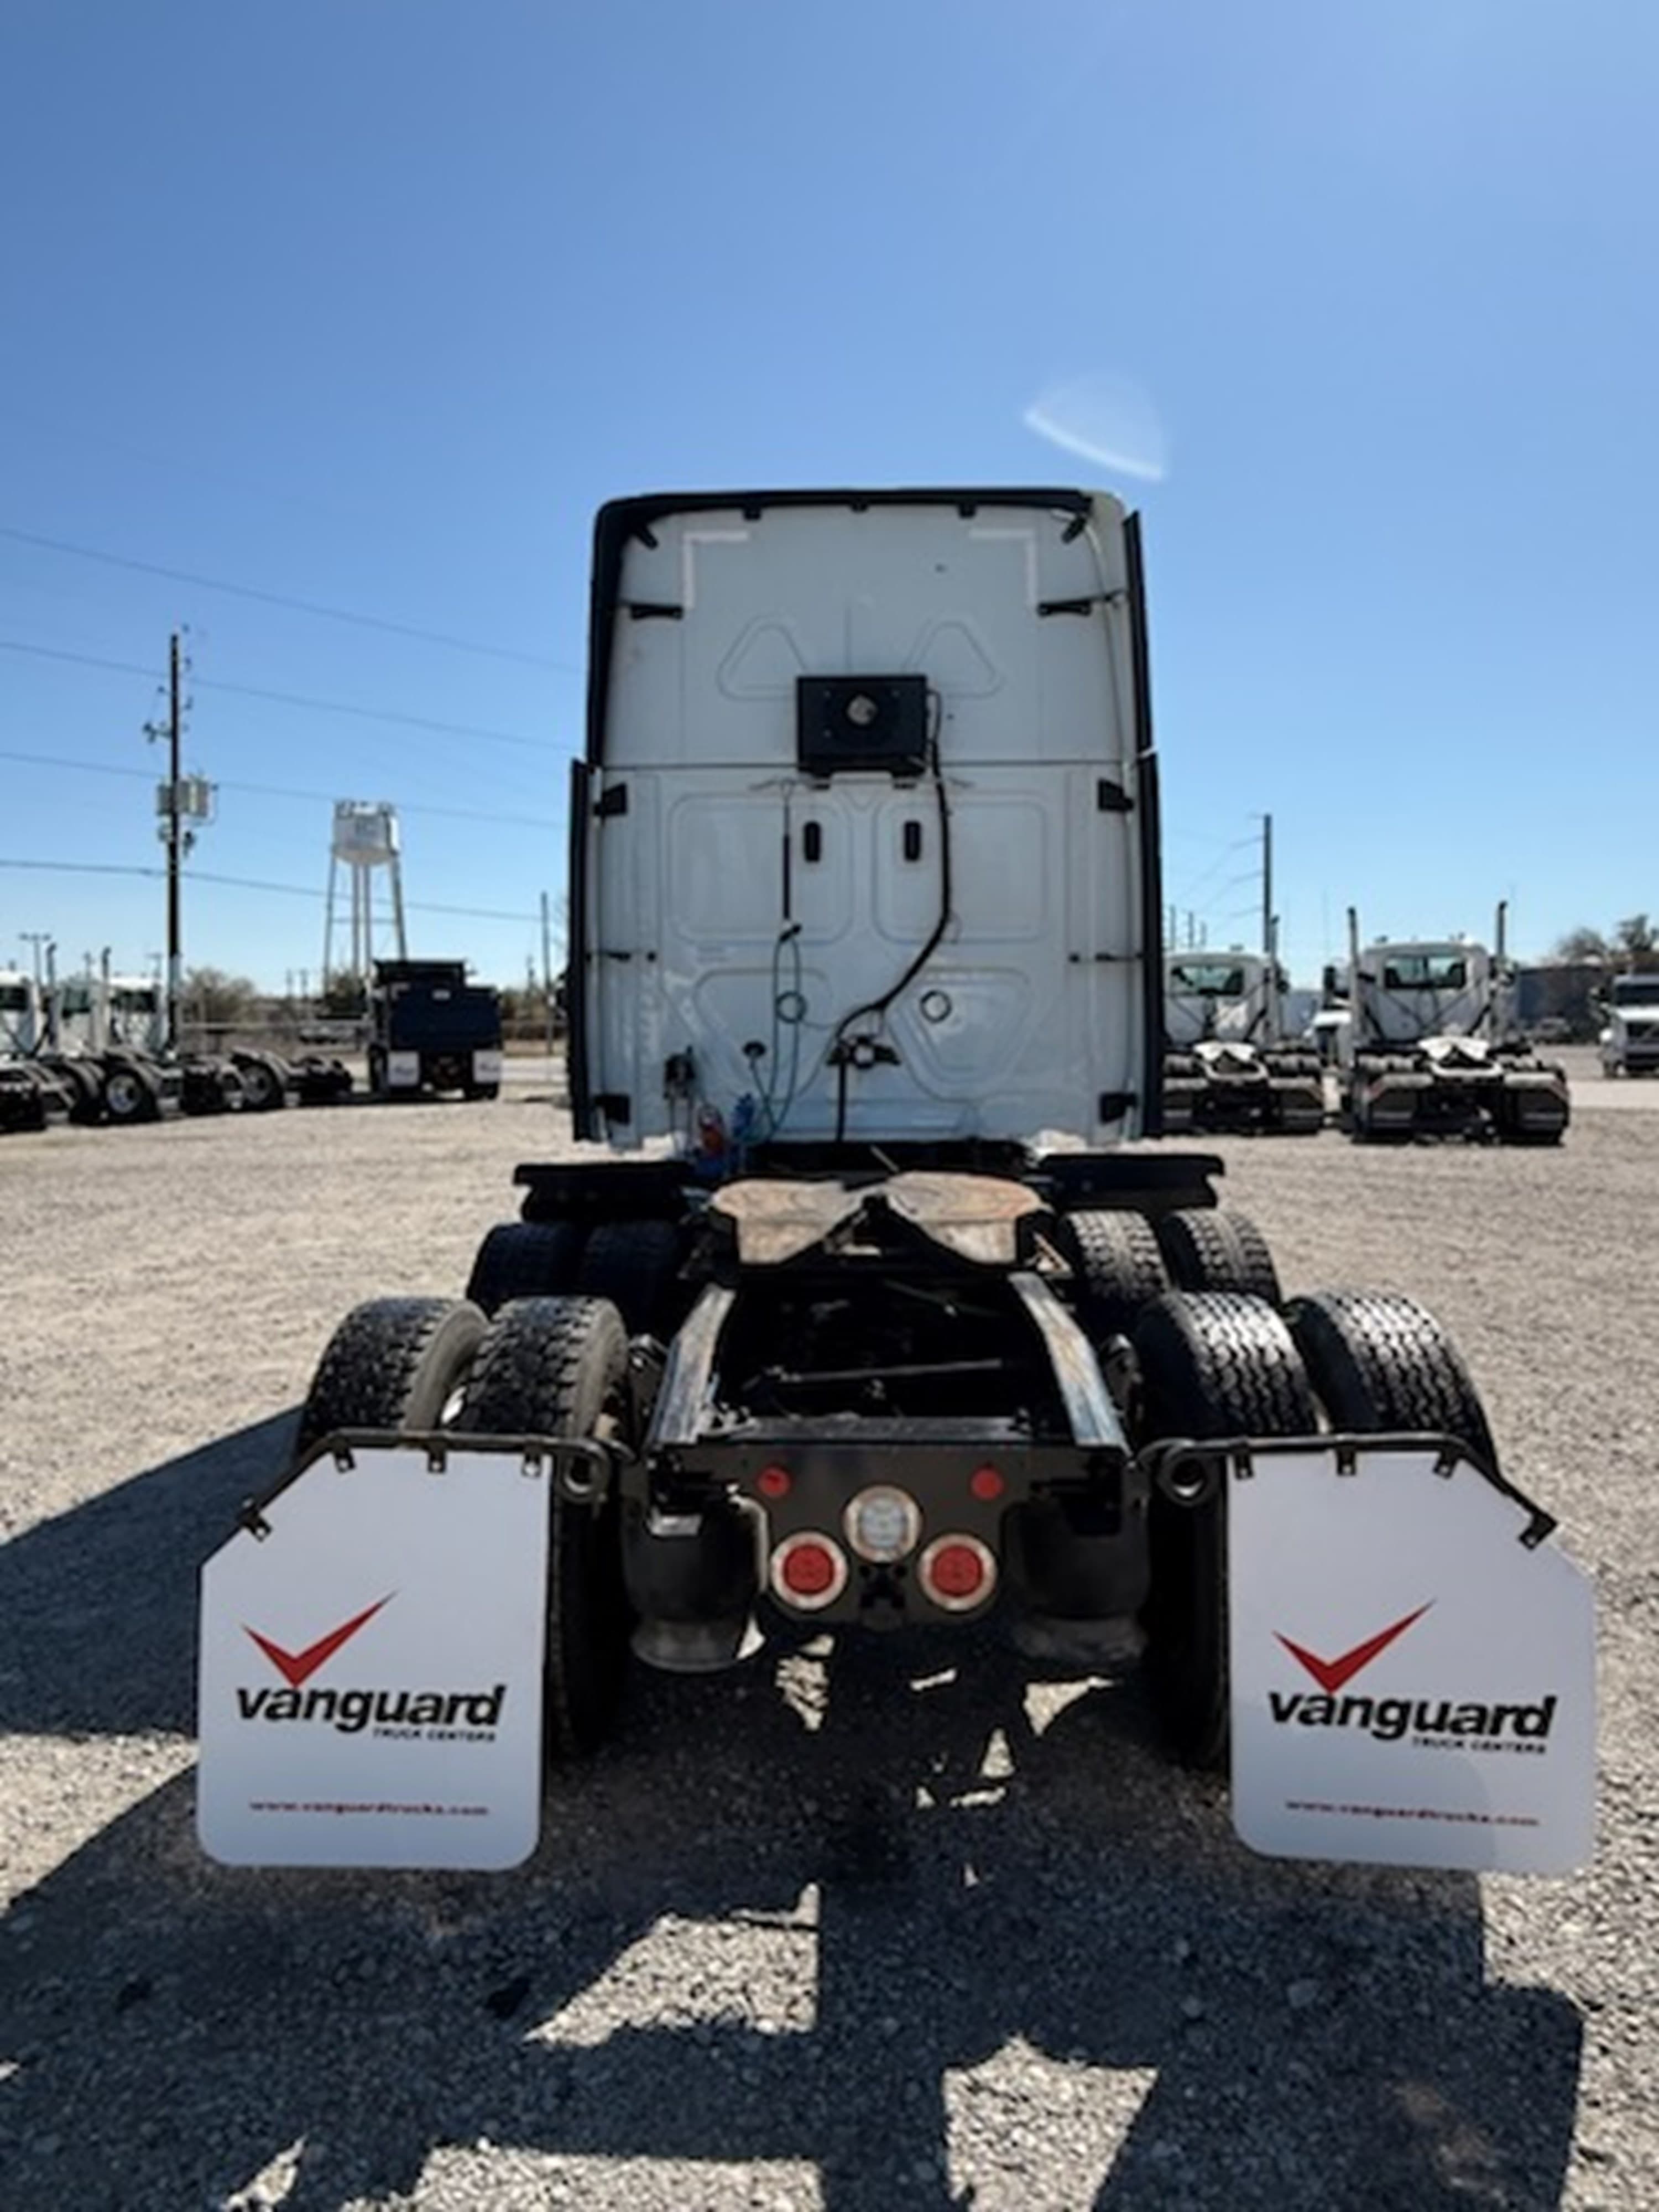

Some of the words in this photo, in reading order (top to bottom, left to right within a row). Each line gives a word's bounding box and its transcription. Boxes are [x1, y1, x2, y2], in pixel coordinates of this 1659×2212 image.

[237, 1685, 505, 1733] vanguard
[1269, 1692, 1557, 1740] vanguard
[373, 1728, 421, 1740] TRUCK
[427, 1730, 495, 1742] CENTERS
[1412, 1736, 1464, 1750] TRUCK
